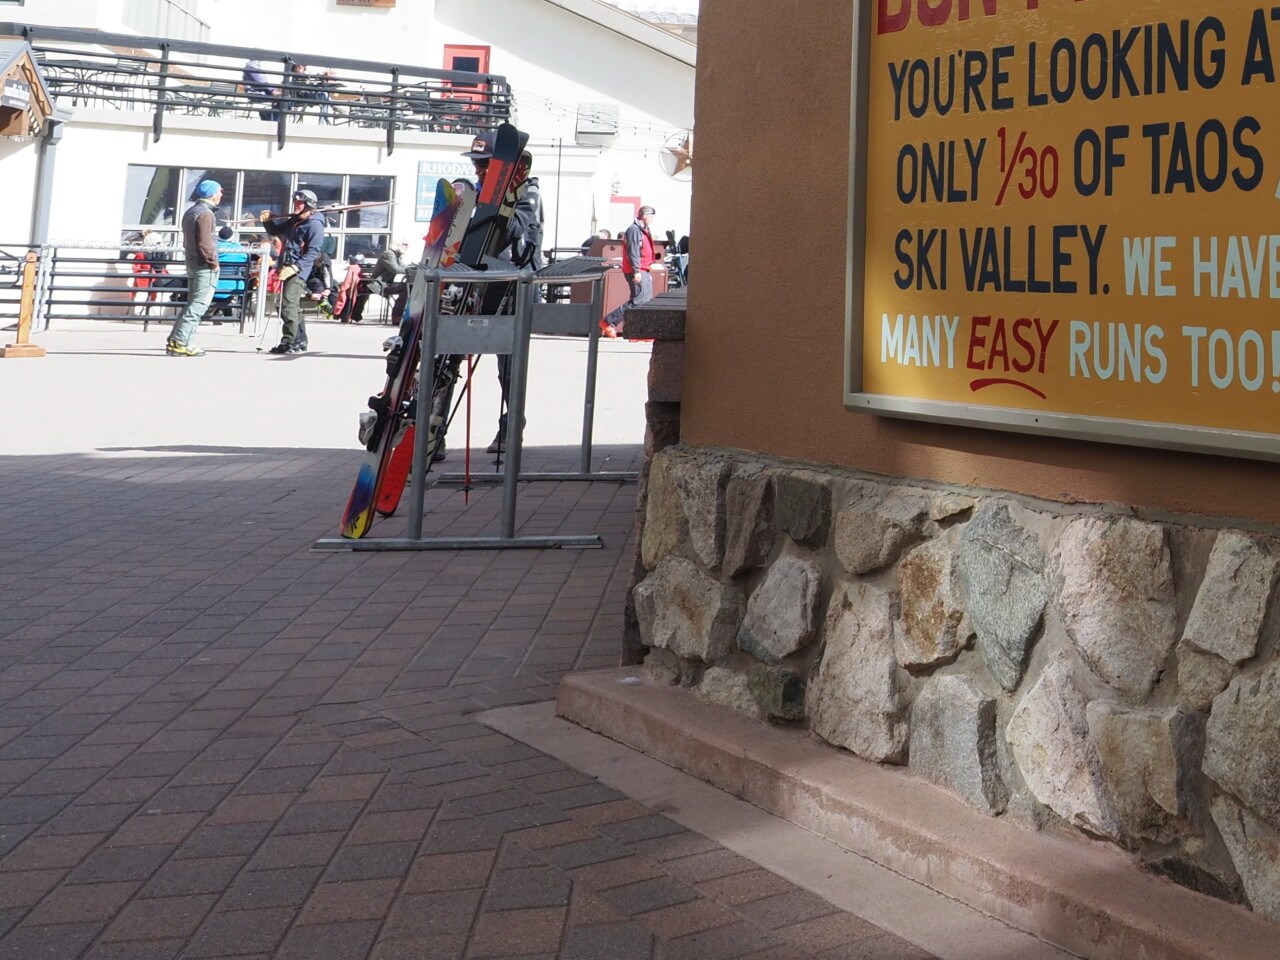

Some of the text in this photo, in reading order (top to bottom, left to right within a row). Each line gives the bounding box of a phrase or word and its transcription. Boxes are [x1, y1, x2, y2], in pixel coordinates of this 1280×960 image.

[888, 45, 1015, 121] YOU'RE
[1028, 16, 1226, 107] LOOKING
[897, 116, 1264, 206] ONLY 1/30 OF TAOS
[894, 228, 947, 291] SKI
[959, 224, 1110, 295] VALLEY.
[1122, 236, 1176, 297] WE
[880, 313, 959, 369] MANY
[966, 315, 1060, 374] EASY
[1070, 320, 1168, 384] RUNS
